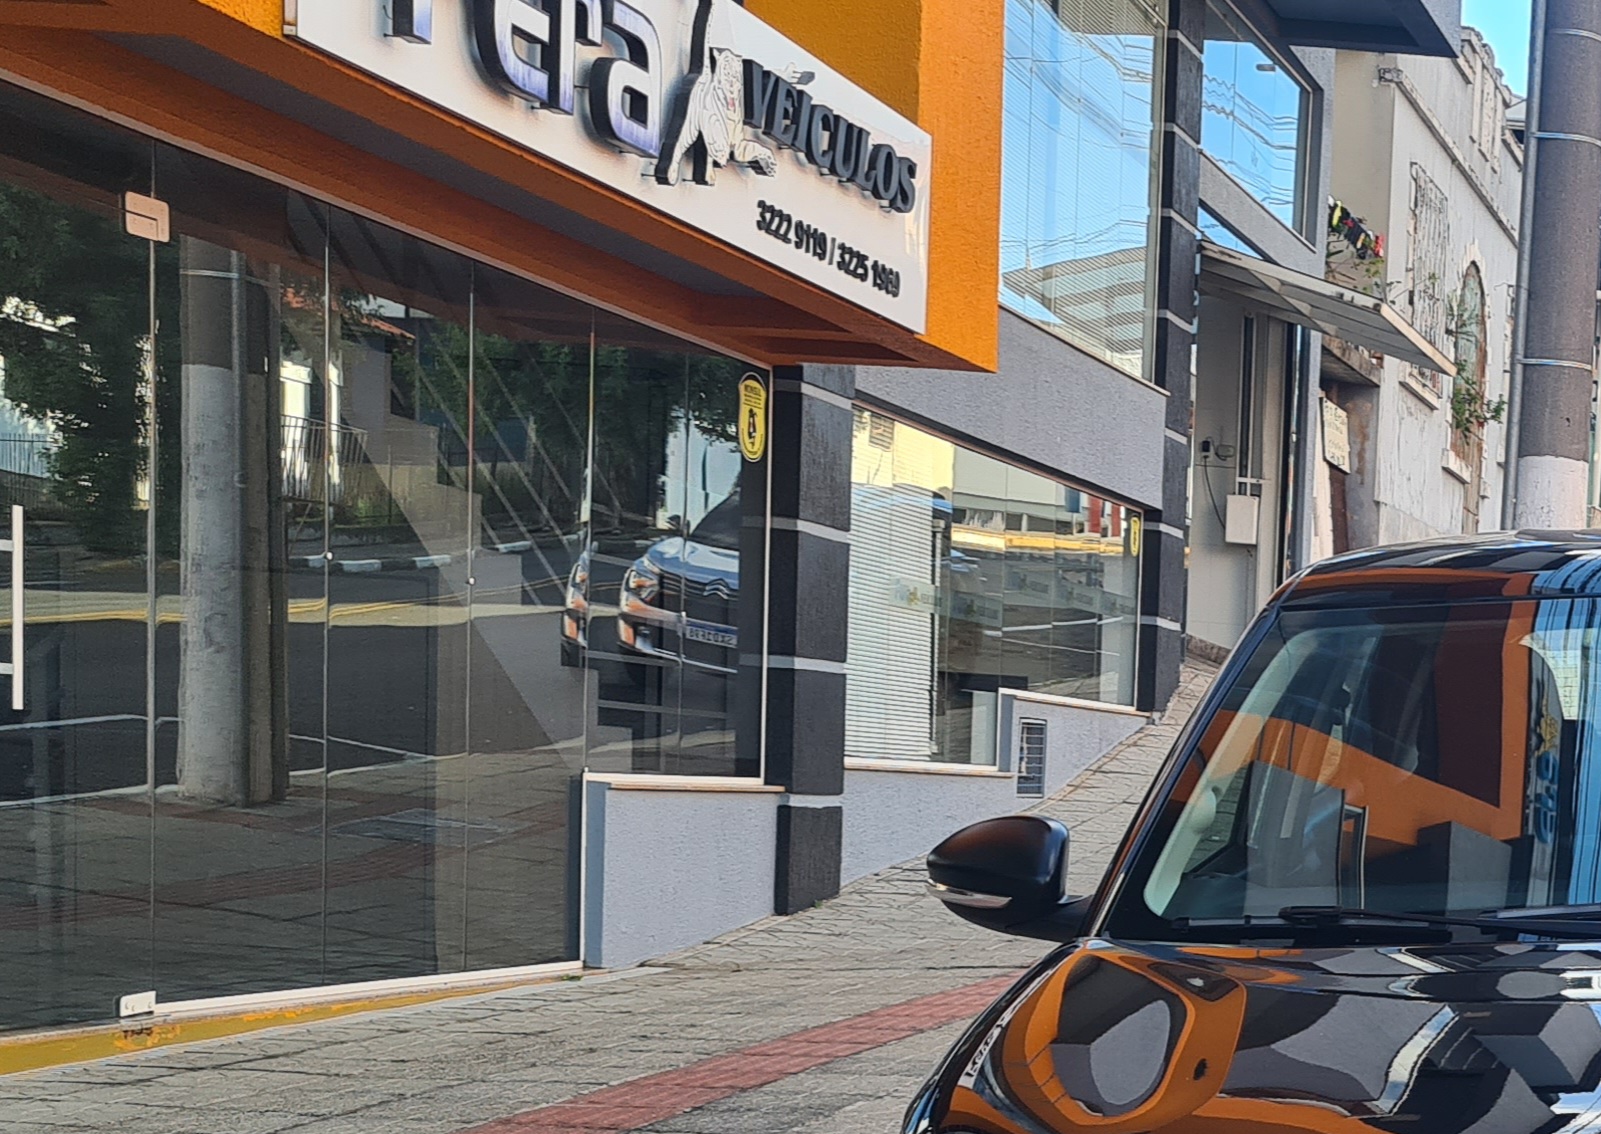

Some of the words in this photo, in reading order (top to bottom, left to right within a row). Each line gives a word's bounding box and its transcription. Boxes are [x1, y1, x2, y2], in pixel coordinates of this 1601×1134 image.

[393, 0, 662, 158] era
[742, 58, 917, 213] VEÍCULOS
[757, 199, 792, 244] 3222
[794, 219, 827, 261] 9119
[837, 242, 869, 282] 3225
